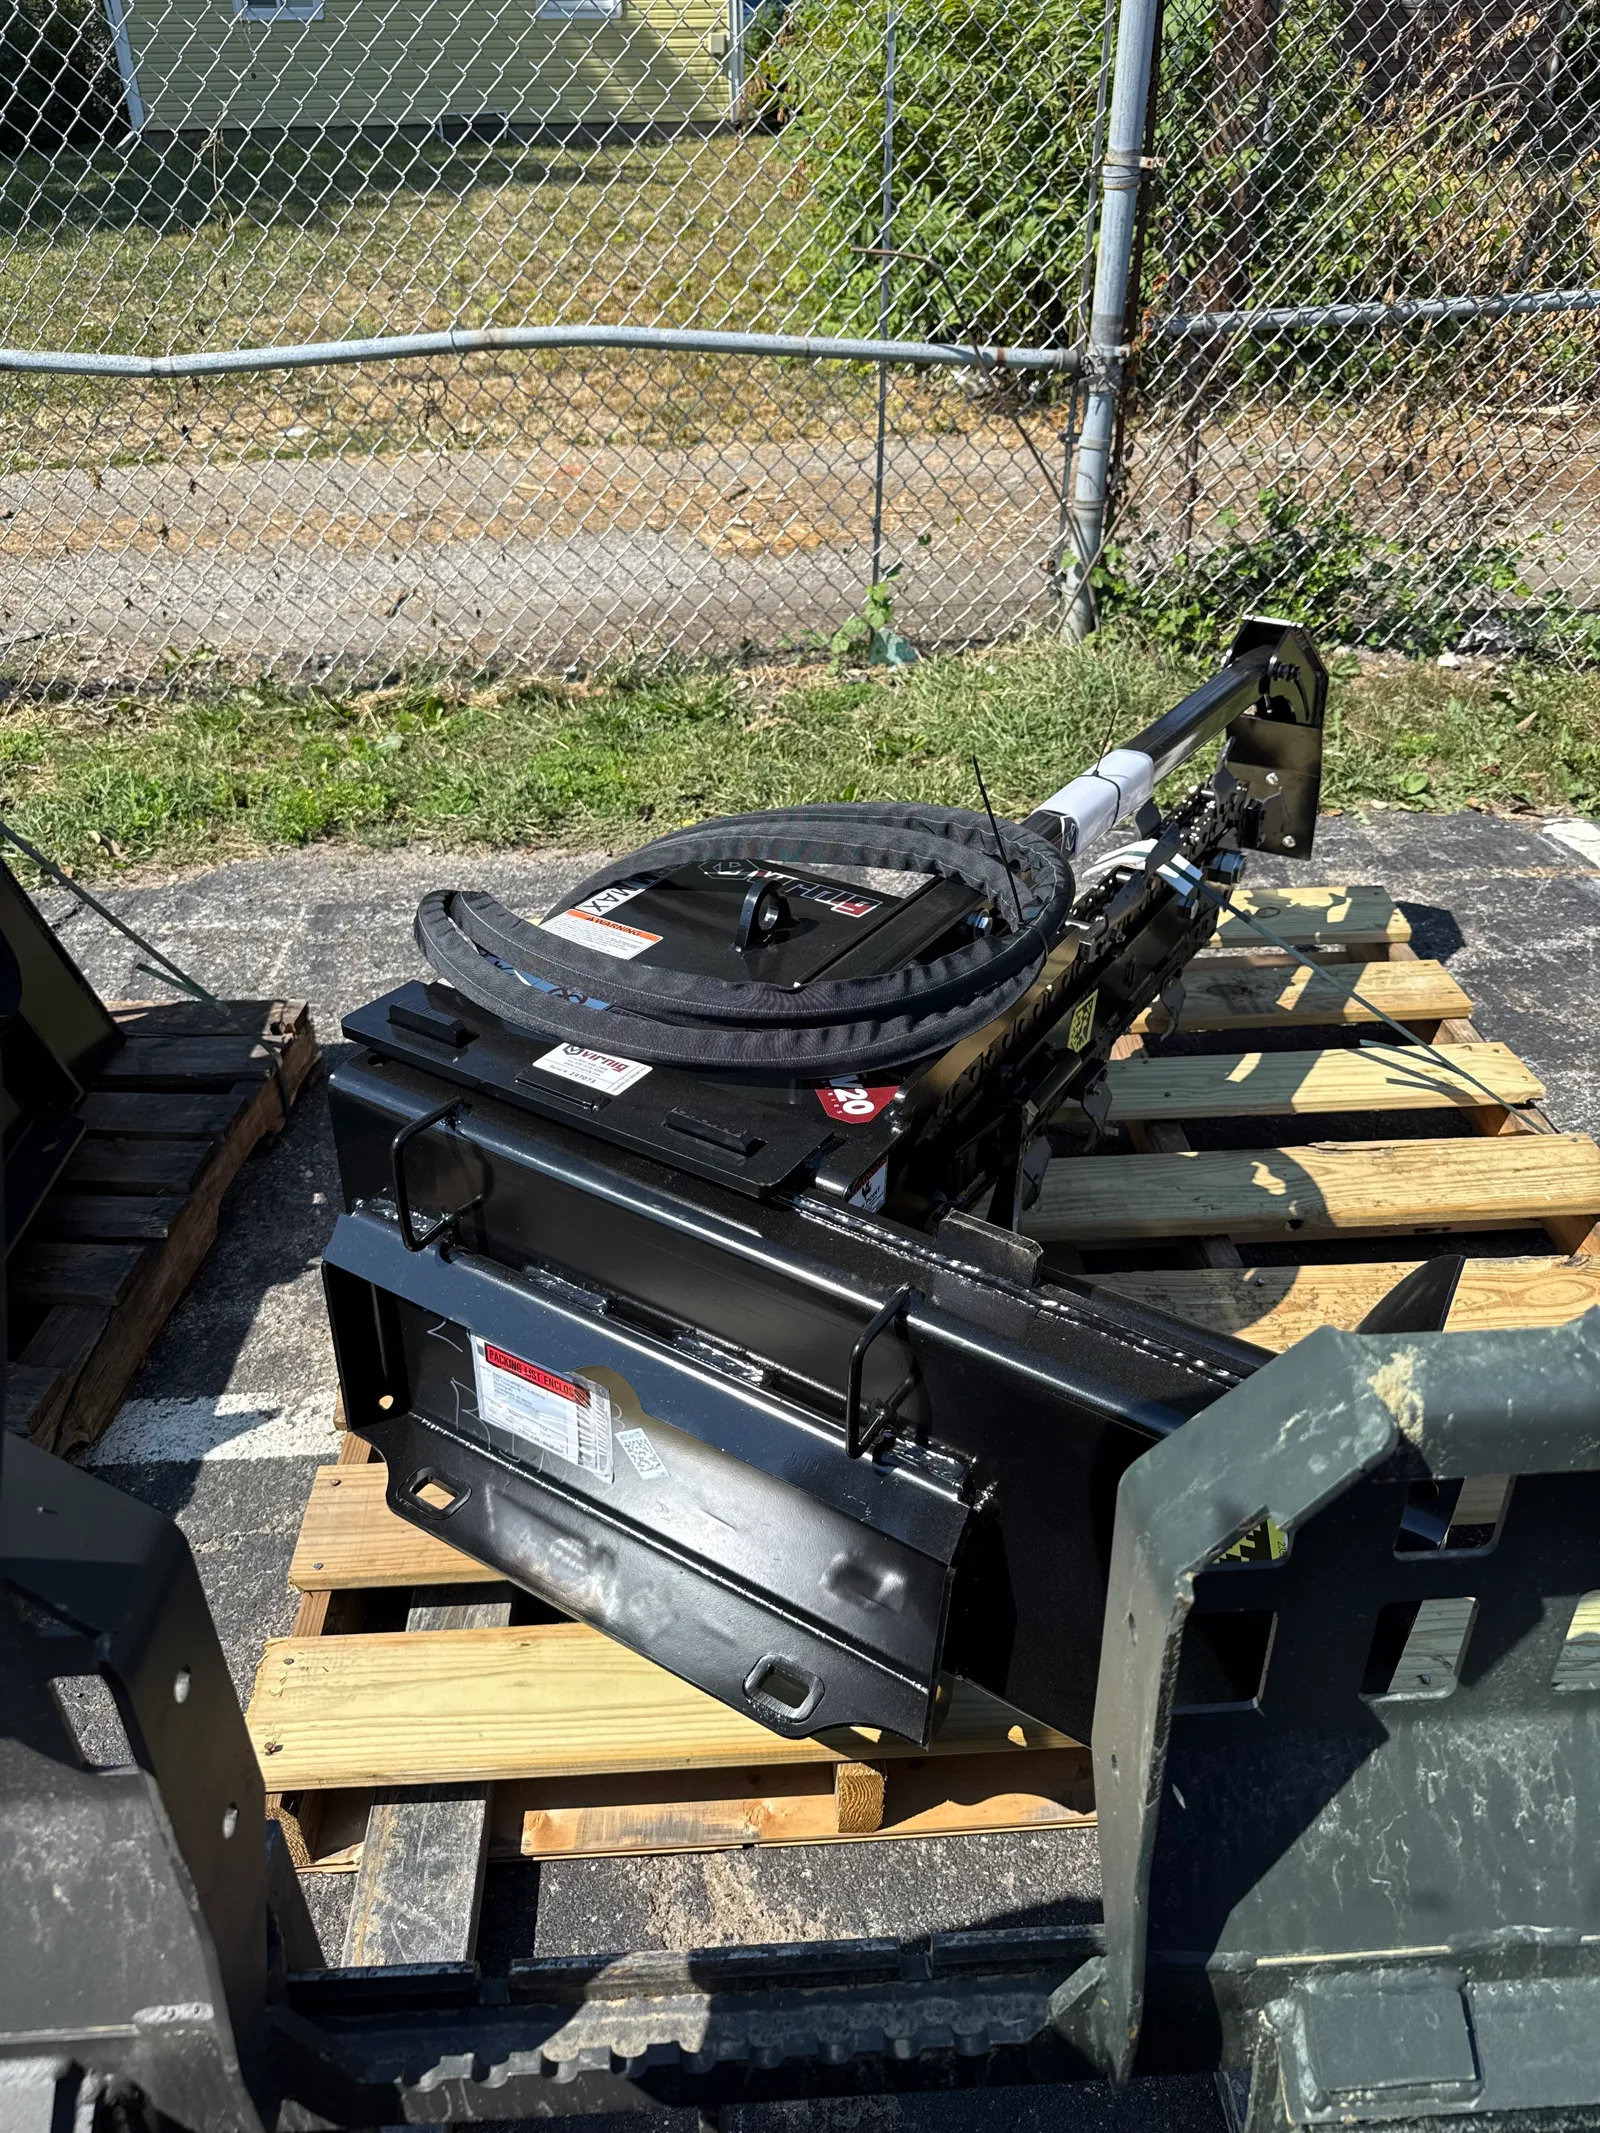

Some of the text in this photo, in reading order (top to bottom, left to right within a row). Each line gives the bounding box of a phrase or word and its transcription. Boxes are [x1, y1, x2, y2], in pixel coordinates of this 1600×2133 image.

[583, 883, 639, 913] MAX
[595, 918, 642, 936] WARNING
[581, 1050, 630, 1073] virnig
[828, 1074, 875, 1115] V20
[488, 1349, 523, 1373] PACKING
[524, 1366, 542, 1384] LIST
[543, 1376, 583, 1401] ENCLOS
